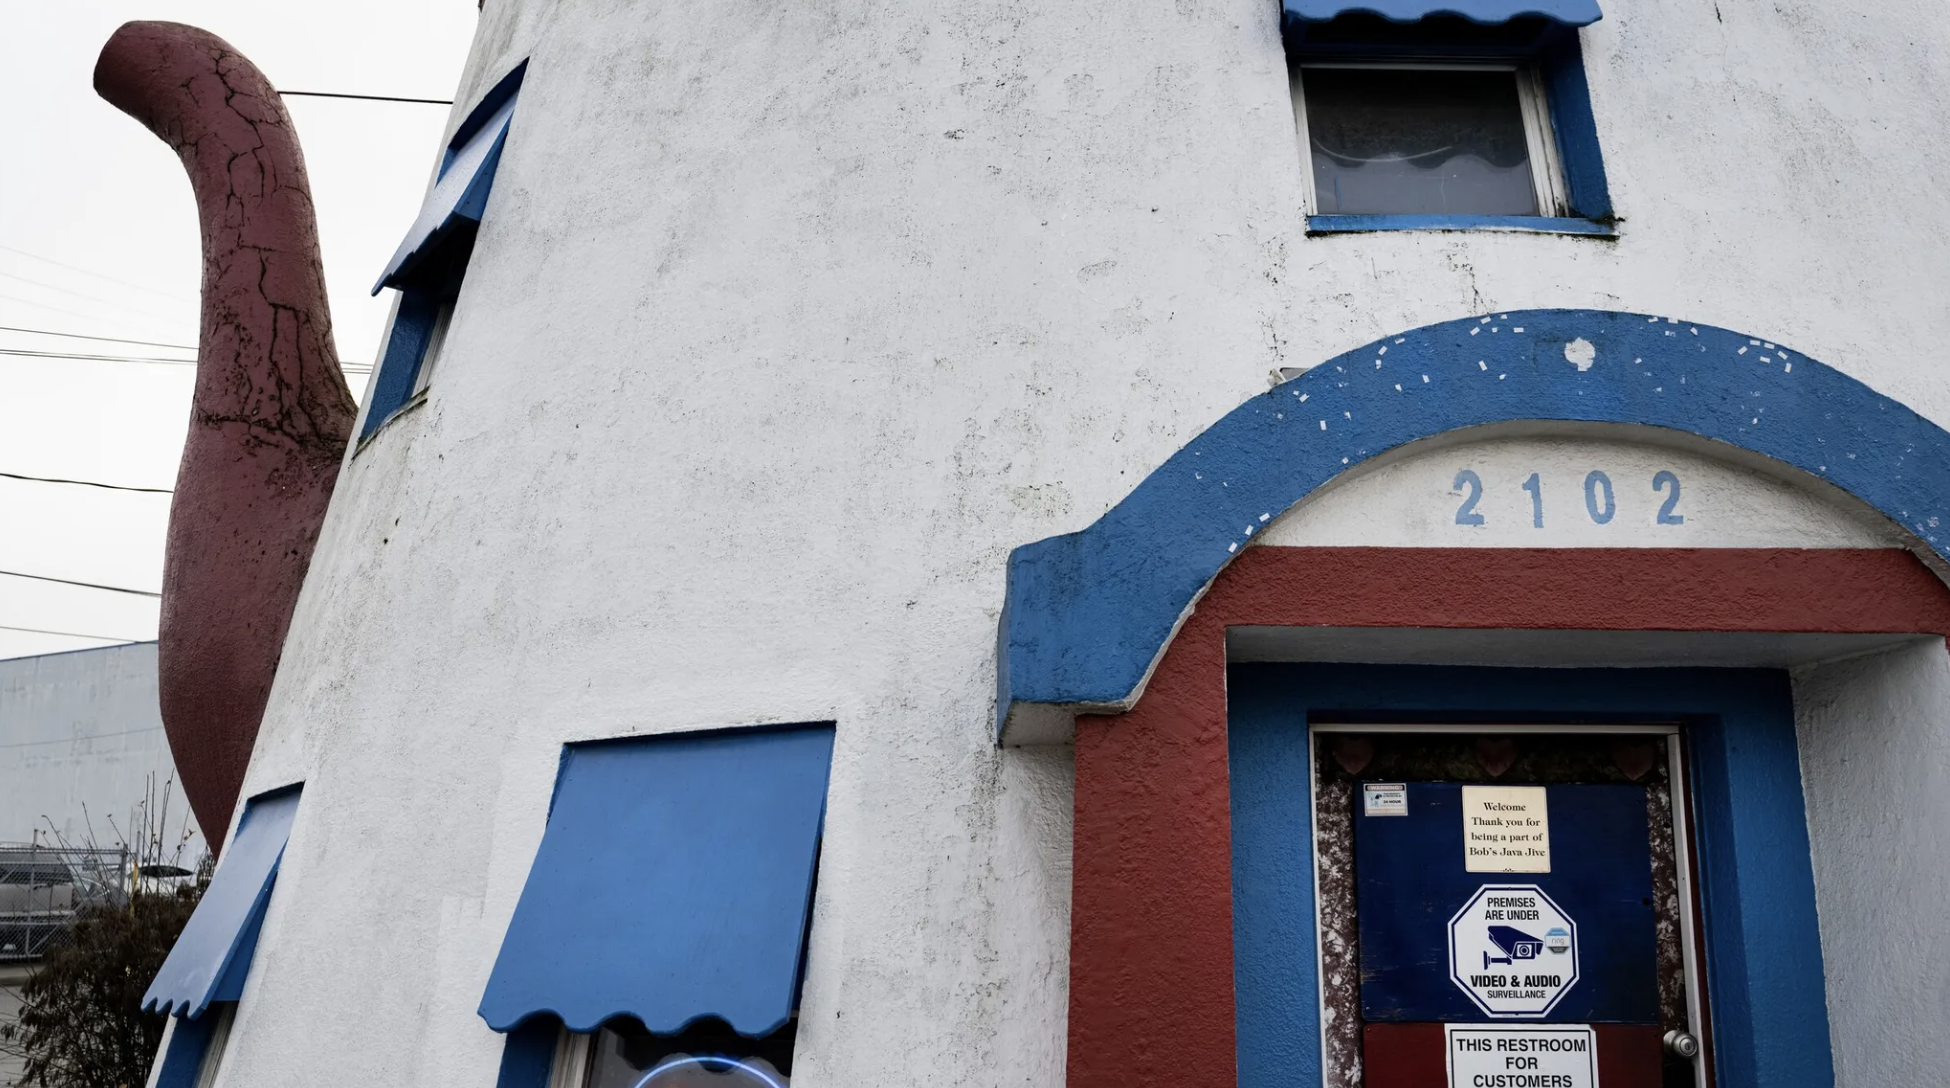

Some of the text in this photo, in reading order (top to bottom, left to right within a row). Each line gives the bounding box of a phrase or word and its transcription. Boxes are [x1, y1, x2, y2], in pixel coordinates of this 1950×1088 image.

[1453, 470, 1684, 528] 2102
[1483, 802, 1526, 811] Welcome
[1471, 817, 1541, 828] Thank you for
[1471, 832, 1498, 842] being
[1509, 833, 1529, 843] part
[1532, 833, 1543, 841] of
[1469, 847, 1545, 856] Bob's Java Jive
[1487, 897, 1536, 908] PREMISES
[1485, 909, 1539, 921] ARE UNDER
[1551, 937, 1565, 946] ring
[1470, 975, 1561, 987] VIDEO & AUDIO
[1487, 990, 1546, 999] SURVEILLANCE
[1456, 1038, 1586, 1052] THIS RESTROOM
[1505, 1057, 1538, 1070] FOR
[1473, 1074, 1572, 1088] CUSTOMERS
